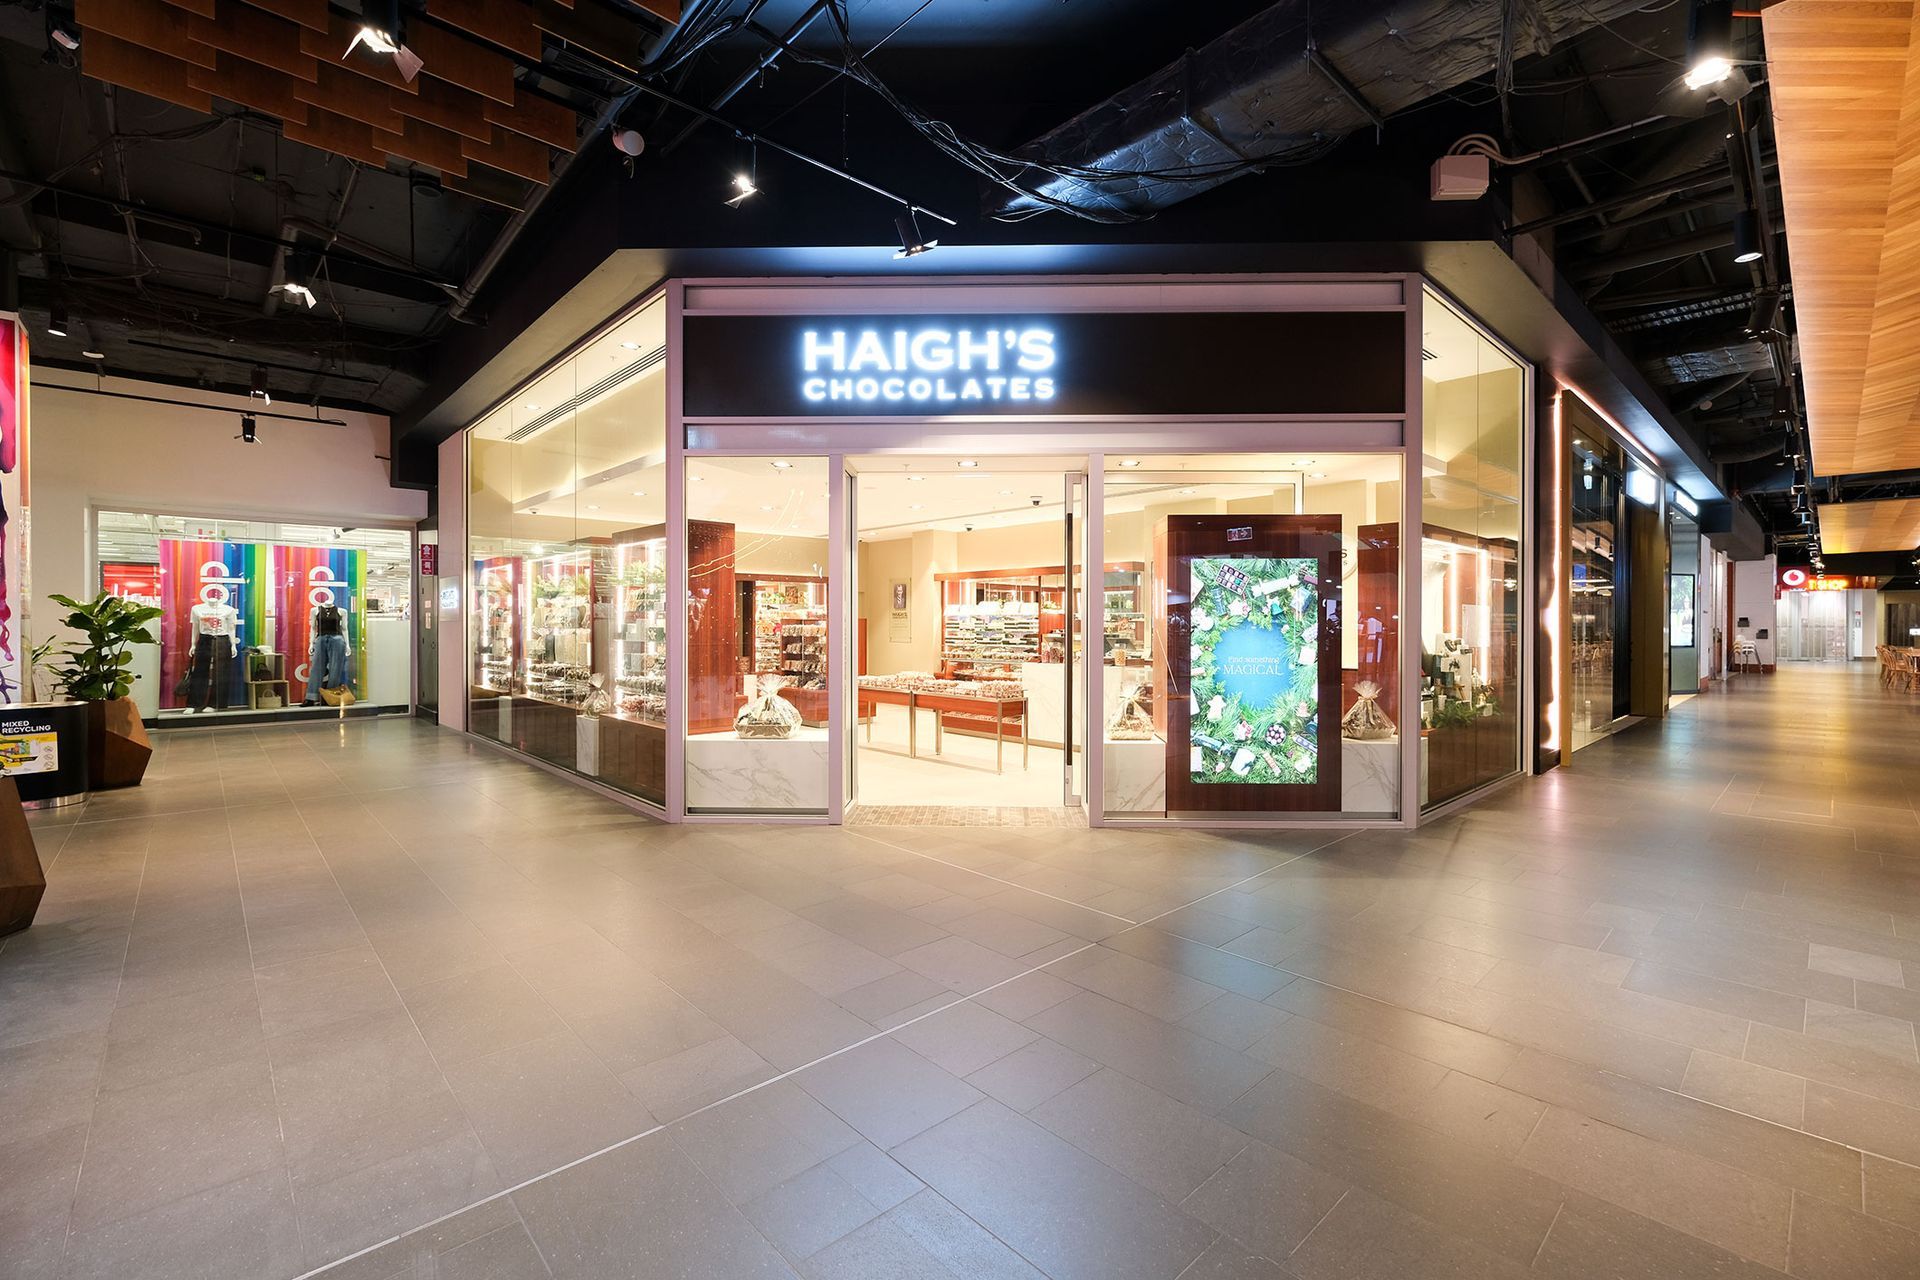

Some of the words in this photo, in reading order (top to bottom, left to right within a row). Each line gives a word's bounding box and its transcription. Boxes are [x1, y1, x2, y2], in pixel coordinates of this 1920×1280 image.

[803, 329, 1056, 371] HAIGH'S
[803, 377, 1056, 400] CHOCOLATES
[1244, 656, 1280, 664] something
[1223, 664, 1285, 676] MAGICAL
[2, 725, 51, 733] RECYCLING
